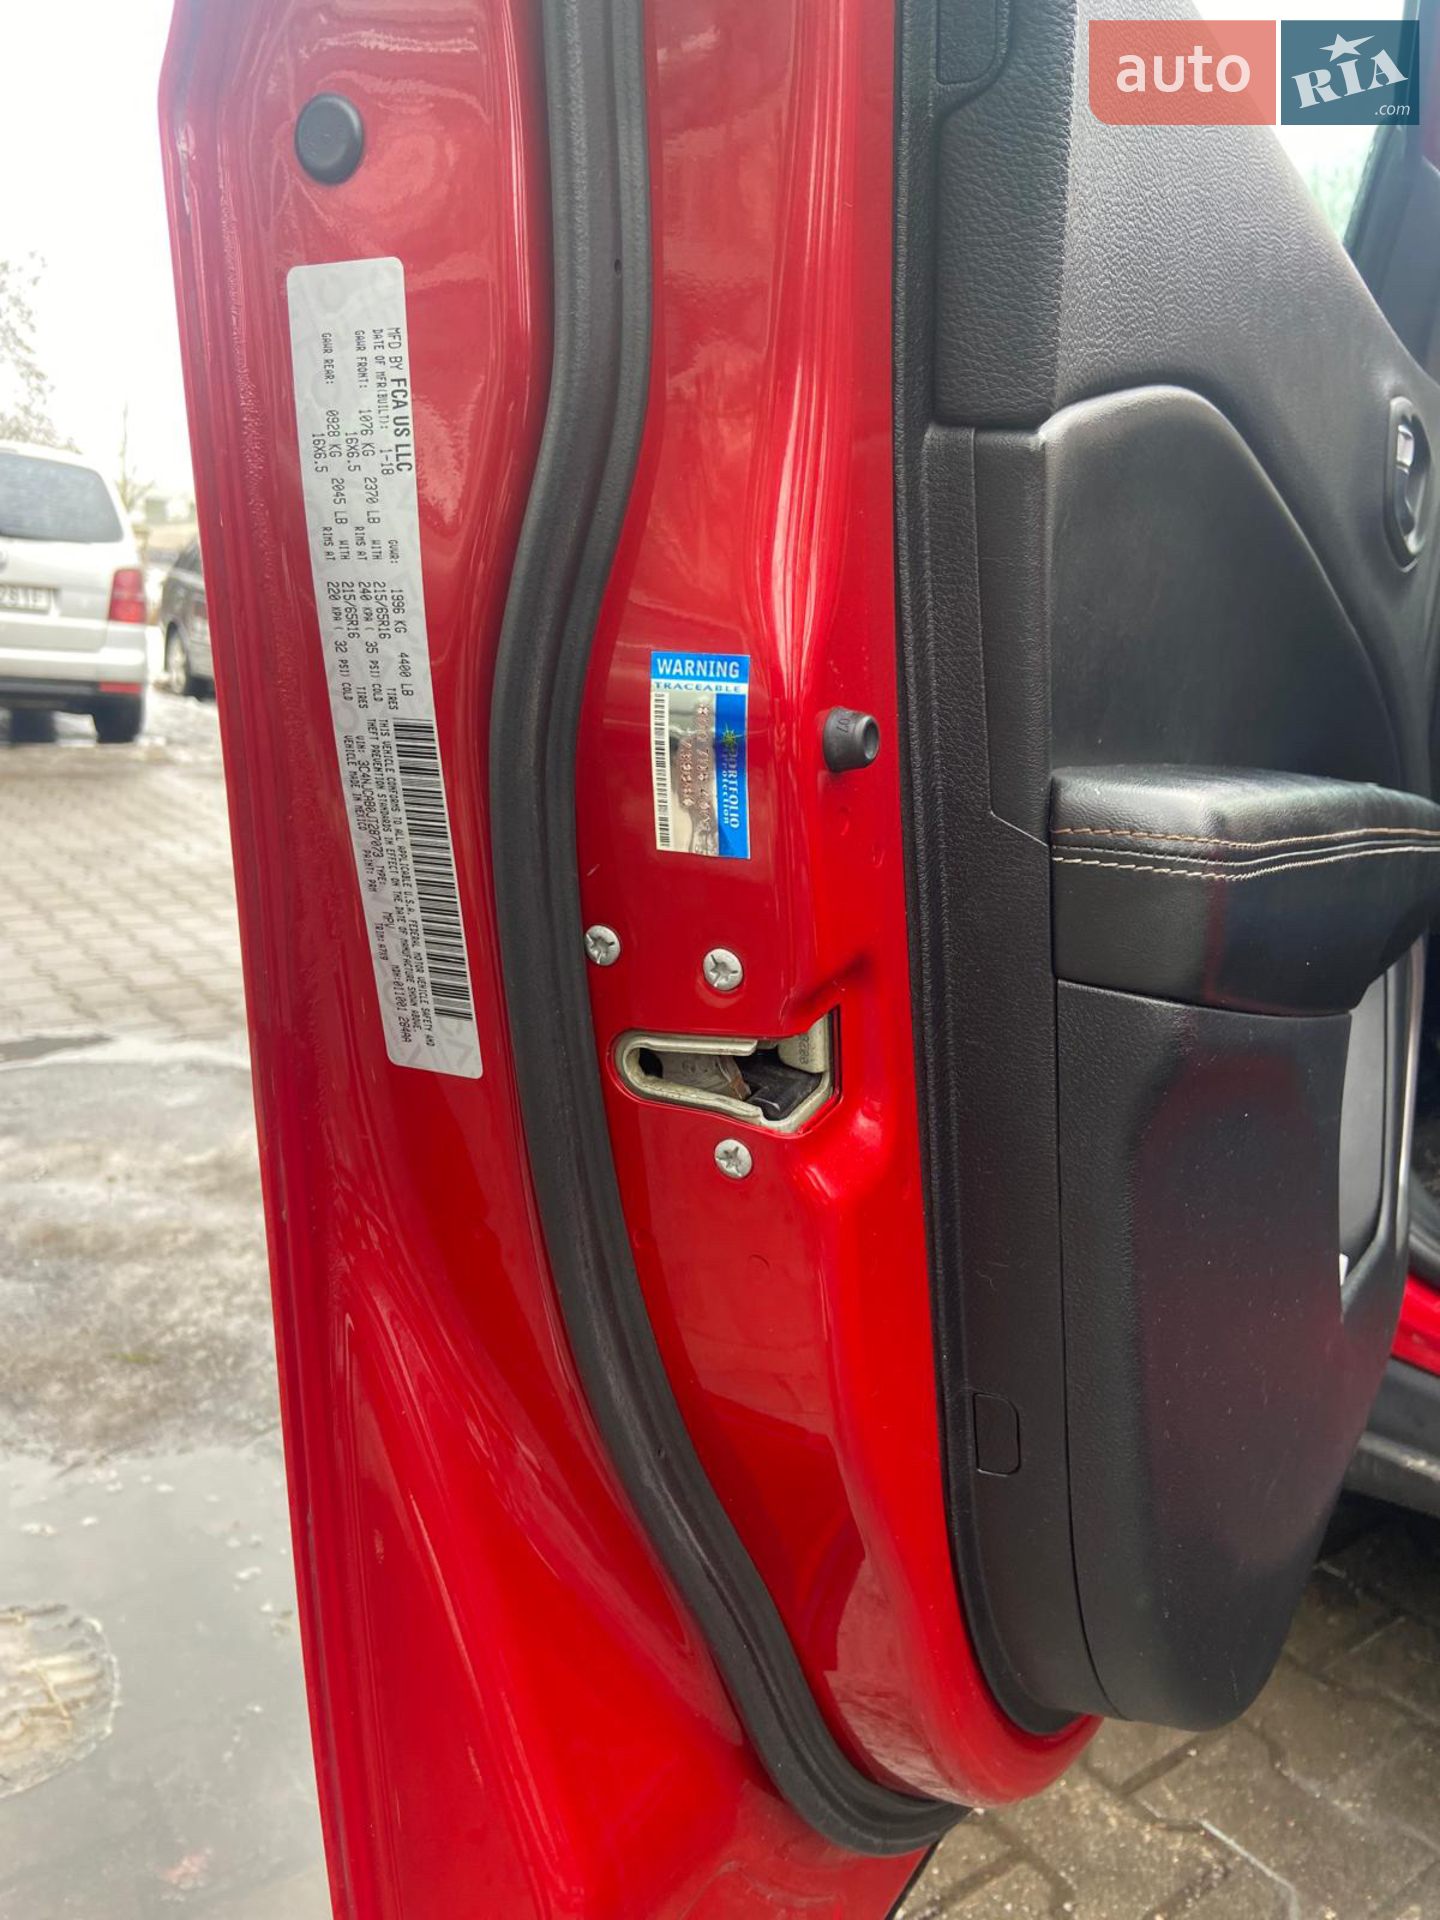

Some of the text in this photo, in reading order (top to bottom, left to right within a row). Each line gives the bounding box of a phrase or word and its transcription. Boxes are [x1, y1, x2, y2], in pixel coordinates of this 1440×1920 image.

[387, 327, 413, 472] MFD BY FCA US LLC
[311, 433, 329, 473] 16X6.5
[344, 431, 362, 472] 16X6.5
[321, 332, 369, 709] GAWR REAR: 0928 KG 2045 LB WITH 215/65R16 TIRES
[354, 329, 399, 711] GAWR FRONT: 1076 KG 2370 LB WITH 215/65R16 TIRES
[372, 328, 415, 697] DATE OF MFR(BUILT): 1-18 GVWR: 1996 KG 4400 LB
[322, 526, 335, 547] RIMS
[354, 525, 367, 547] RIMS
[324, 550, 336, 561] AT
[356, 550, 368, 561] AT
[326, 581, 342, 601] 220
[357, 581, 373, 602] 240
[331, 606, 343, 622] KPA
[362, 606, 374, 622] KPA
[334, 640, 348, 654] 32
[364, 640, 379, 654] 35
[657, 658, 740, 680] WARNING
[341, 681, 354, 701] COLD
[371, 683, 384, 703] COLD
[654, 680, 741, 693] TRACEABLE
[343, 734, 358, 767] VEHICLE
[348, 770, 361, 789] MADE
[728, 746, 740, 829] PORTFOLIO
[351, 792, 363, 802] IN
[354, 804, 368, 832] MEXICO
[355, 735, 367, 754] VIN:
[375, 865, 387, 886] TYPE:
[382, 911, 396, 930] MPV
[362, 849, 375, 875] PAINT:
[366, 718, 423, 1033] THEFT PREVENTION STANDARDS IN EFFECT ON THE DATE OF MANUFACTURE SHOWN ABOVE.
[378, 719, 436, 1047] THIS VEHICLE CONFORMS TO ALL APPLICABLE U.S.A. FEDERAL MOTOR VEHICLE SAFETY AND
